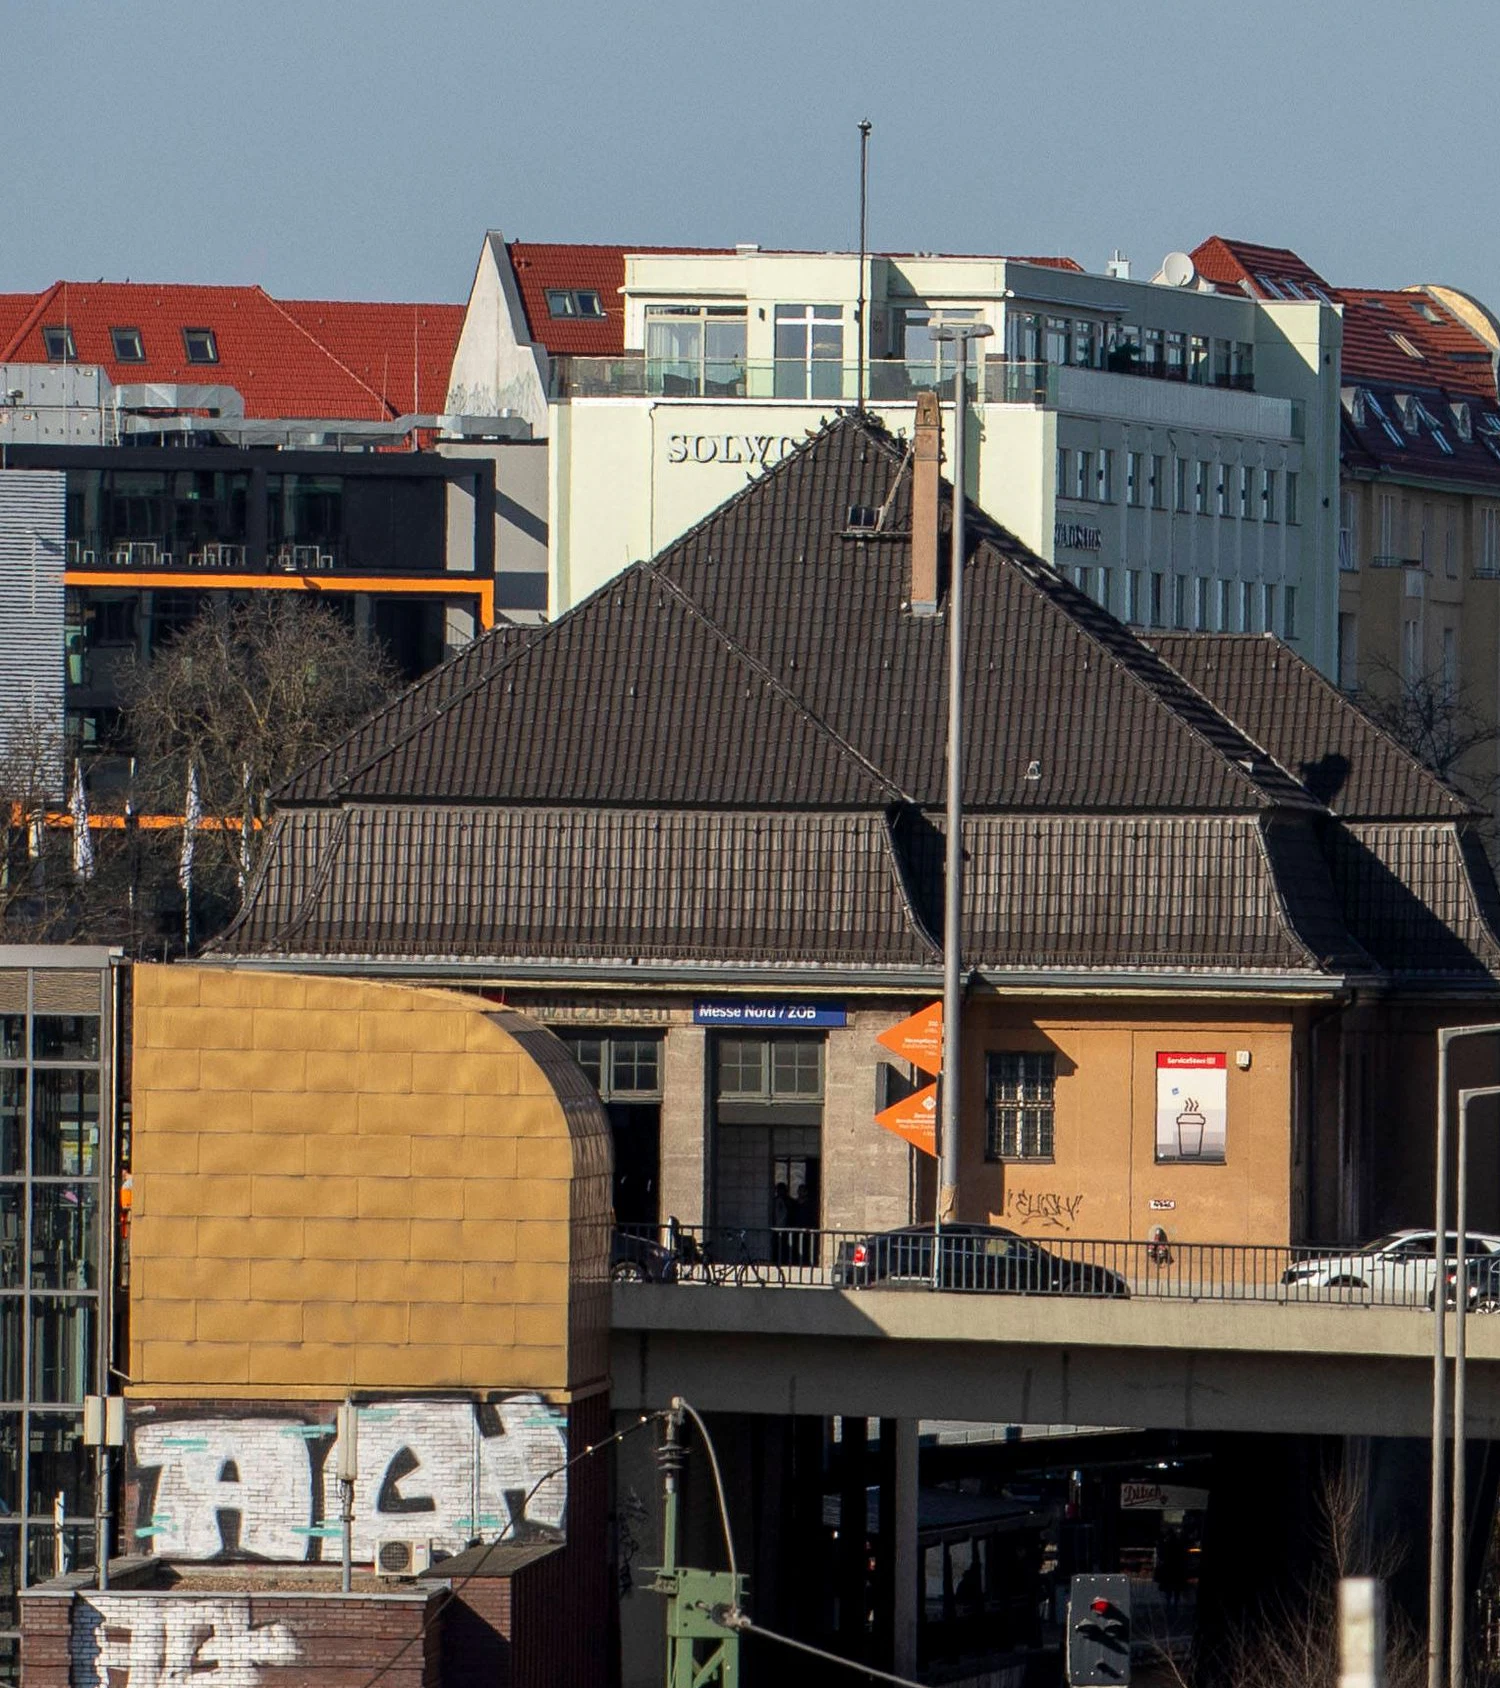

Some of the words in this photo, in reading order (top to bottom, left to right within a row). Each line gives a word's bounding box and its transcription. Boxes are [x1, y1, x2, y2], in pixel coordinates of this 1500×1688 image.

[699, 1005, 741, 1018] Messe
[744, 1005, 777, 1018] Nord
[788, 1006, 817, 1019] ZOB
